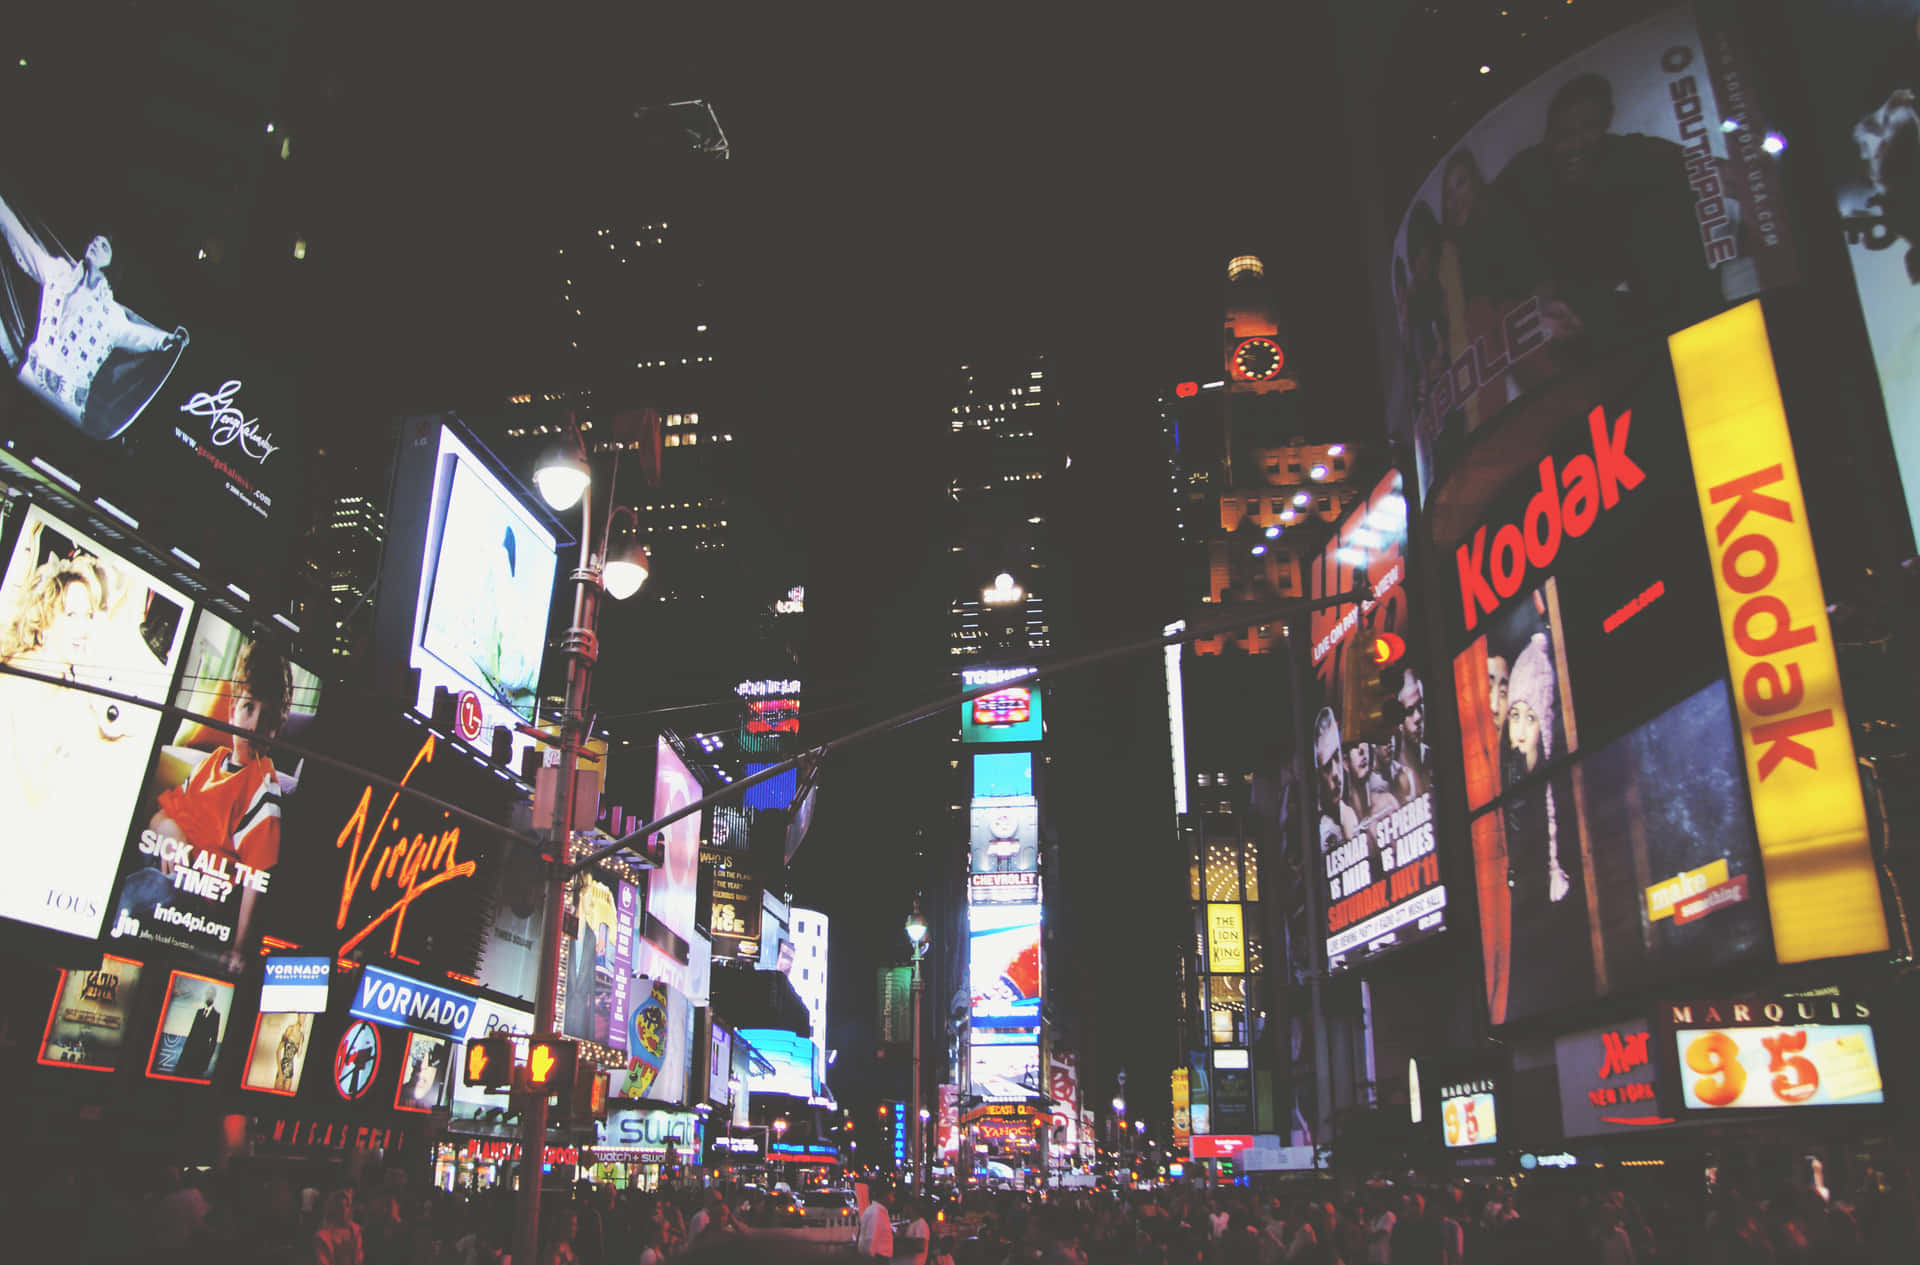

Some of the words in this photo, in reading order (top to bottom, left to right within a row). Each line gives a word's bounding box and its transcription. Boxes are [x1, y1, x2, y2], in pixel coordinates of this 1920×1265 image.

[1456, 405, 1646, 632] Kodak
[1708, 463, 1834, 783] Kodak
[139, 830, 194, 867] SICK
[193, 850, 231, 880] ALL
[234, 862, 271, 893] THE
[336, 734, 476, 958] Virgin
[1326, 833, 1369, 878] LESNAR
[1396, 822, 1435, 867] ALVES
[173, 865, 233, 903] TIME?
[973, 874, 1036, 886] CHEVROLET
[1390, 861, 1420, 902] JULY
[1652, 872, 1707, 911] make
[47, 888, 97, 918] TOUS
[1216, 917, 1235, 926] THE
[153, 903, 231, 942] info4pi.org
[1213, 929, 1239, 945] LION
[266, 965, 330, 977] VORNADO
[1214, 947, 1240, 962] KING
[363, 976, 469, 1030] VORNADO
[1671, 1002, 1870, 1023] MARQUIS
[1441, 1080, 1495, 1098] MARQUIS
[594, 1151, 631, 1162] watch
